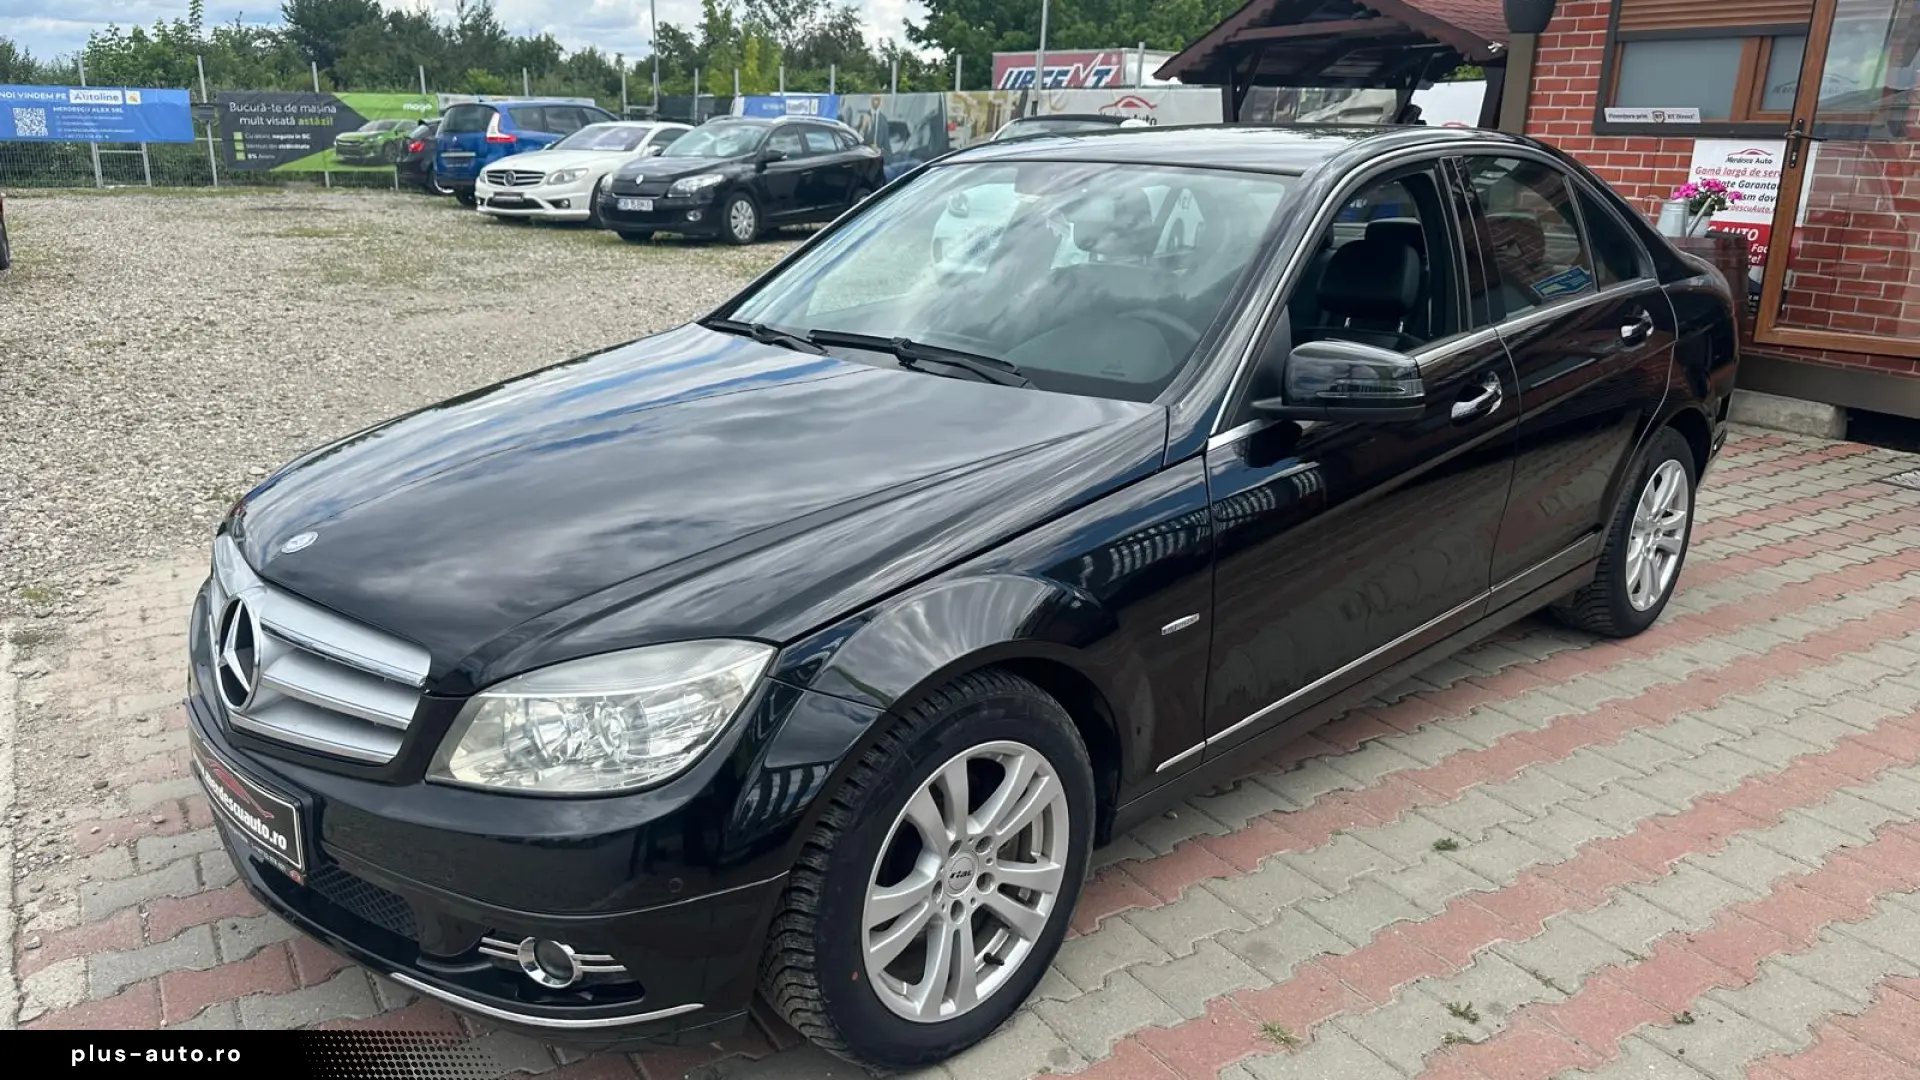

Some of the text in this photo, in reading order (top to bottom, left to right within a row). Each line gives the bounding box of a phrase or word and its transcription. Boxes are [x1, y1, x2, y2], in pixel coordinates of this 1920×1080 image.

[17, 92, 54, 100] VINDEM
[74, 92, 119, 101] Autoline
[229, 101, 282, 113] Bucură-te
[284, 103, 297, 113] de
[403, 103, 433, 113] mogo
[240, 116, 264, 126] mult
[1755, 157, 1773, 165] Auto
[1695, 166, 1720, 175] Gamă
[1749, 167, 1761, 177] de
[1738, 180, 1777, 190] Garanta
